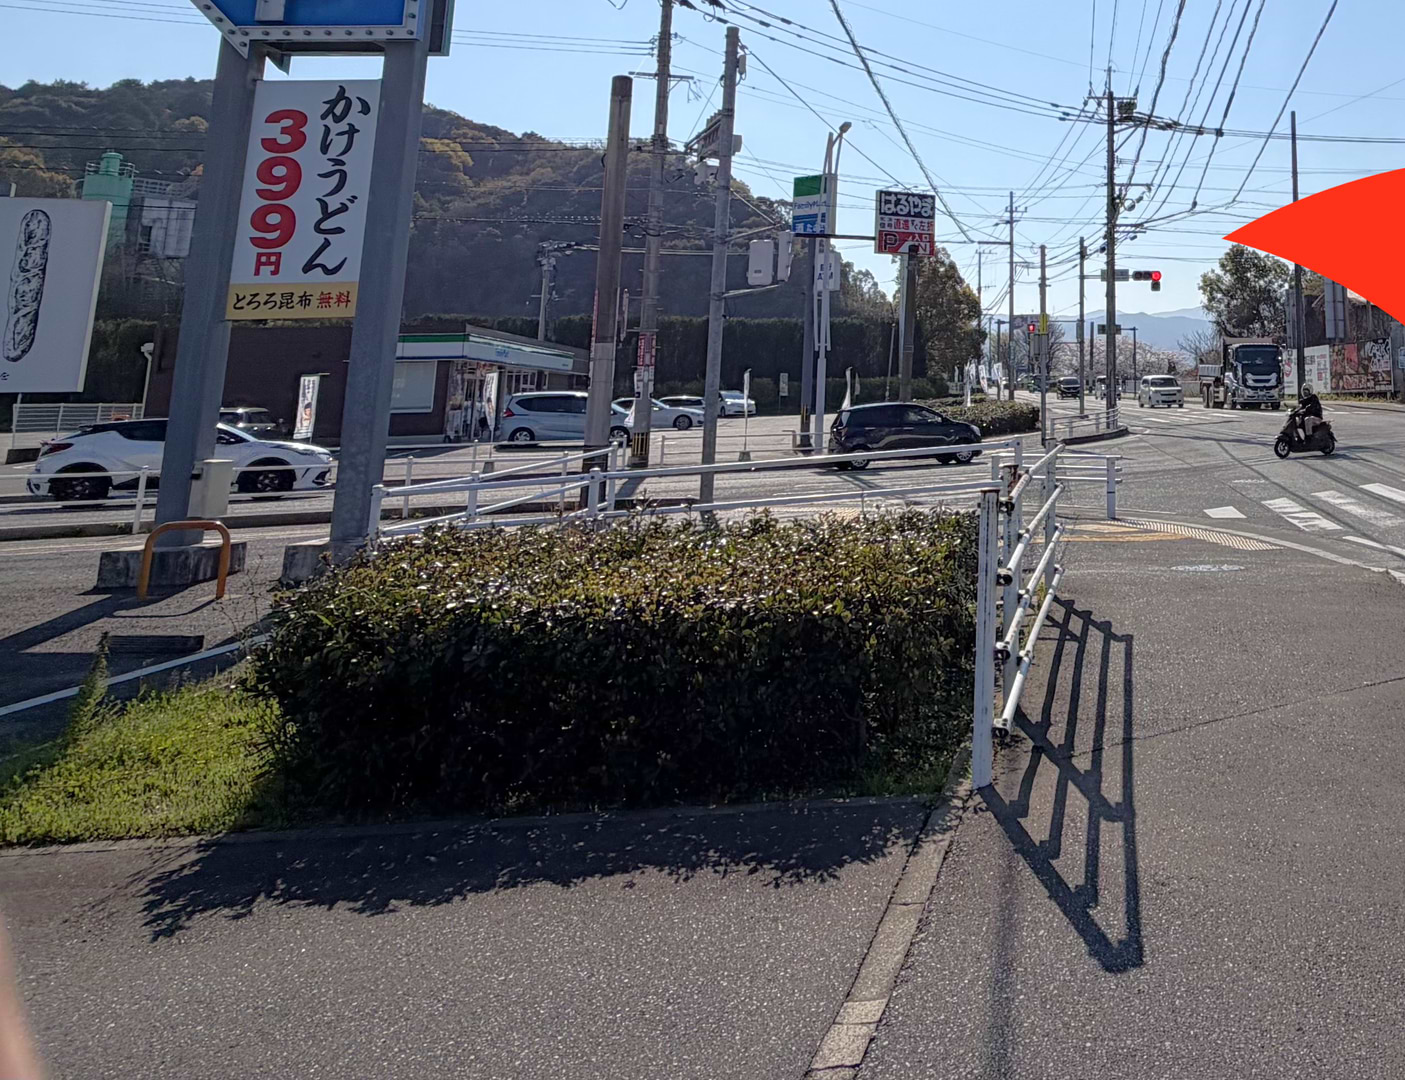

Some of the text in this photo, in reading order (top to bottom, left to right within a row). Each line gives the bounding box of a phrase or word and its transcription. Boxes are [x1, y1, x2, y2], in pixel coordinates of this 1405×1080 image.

[301, 85, 371, 276] かけうどん
[249, 109, 308, 276] 399円
[794, 200, 827, 210] FamilyM
[880, 193, 933, 217] はるやま
[883, 232, 899, 251] P
[232, 291, 351, 311] とろろ昆布 無料
